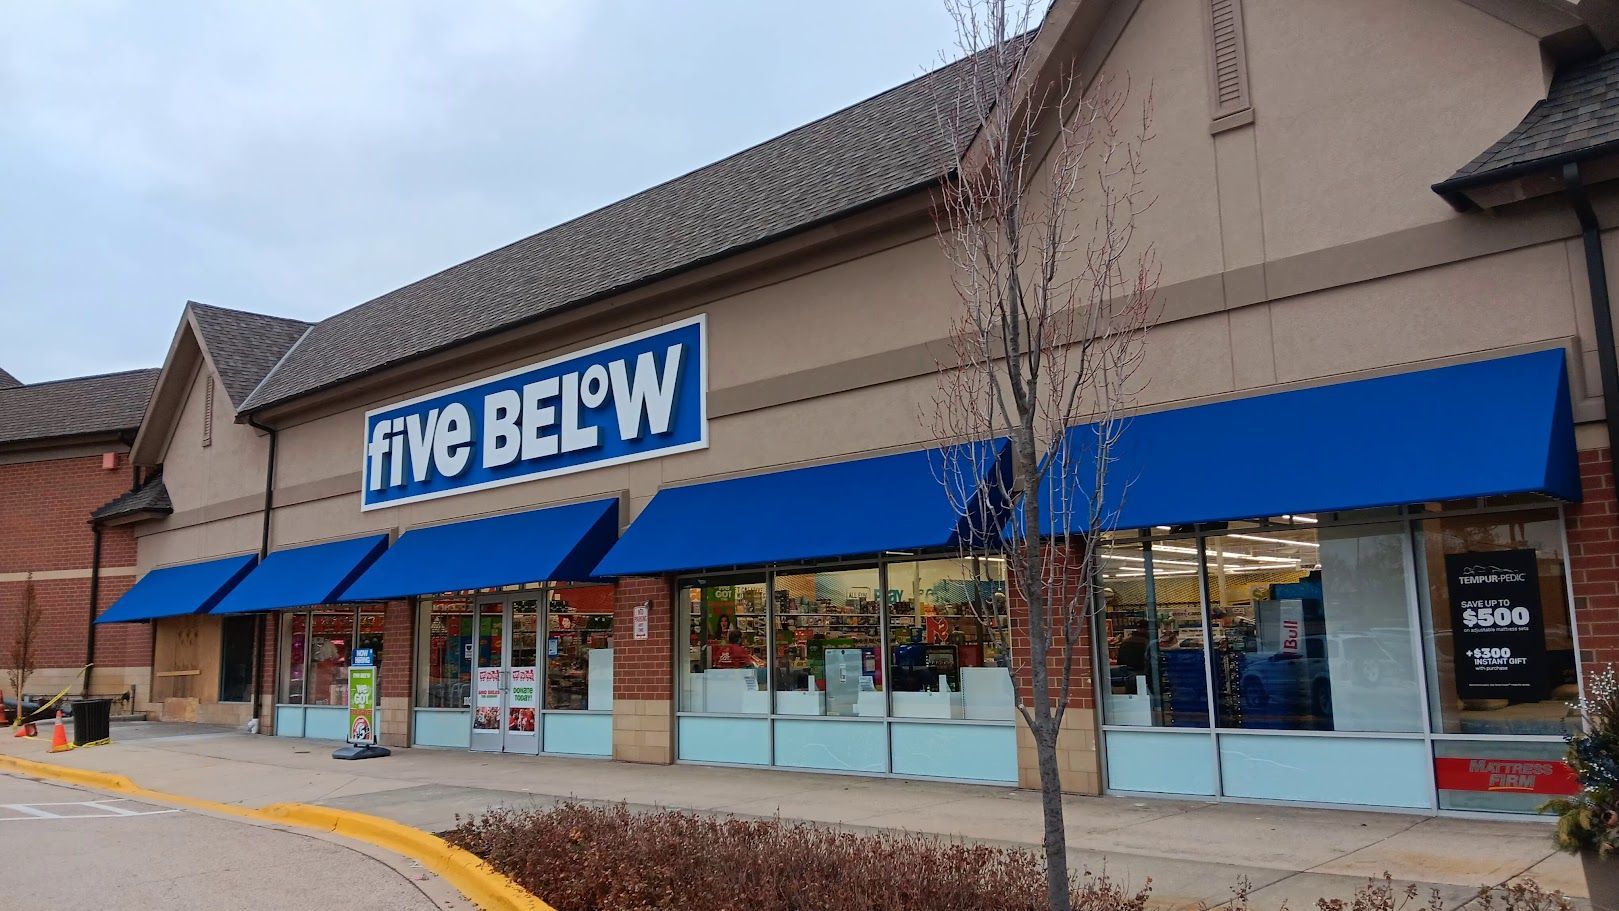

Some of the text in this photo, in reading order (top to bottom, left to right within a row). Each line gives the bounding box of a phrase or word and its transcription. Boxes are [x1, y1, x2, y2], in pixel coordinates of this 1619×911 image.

[1458, 573, 1527, 585] TEMPUR-PEDIC
[1460, 598, 1511, 609] SAVE UP TO
[1462, 606, 1530, 628] $500
[1474, 657, 1528, 665] INSTANT GIFT
[1469, 759, 1553, 775] MATTRESS
[1488, 773, 1537, 788] FIRM
